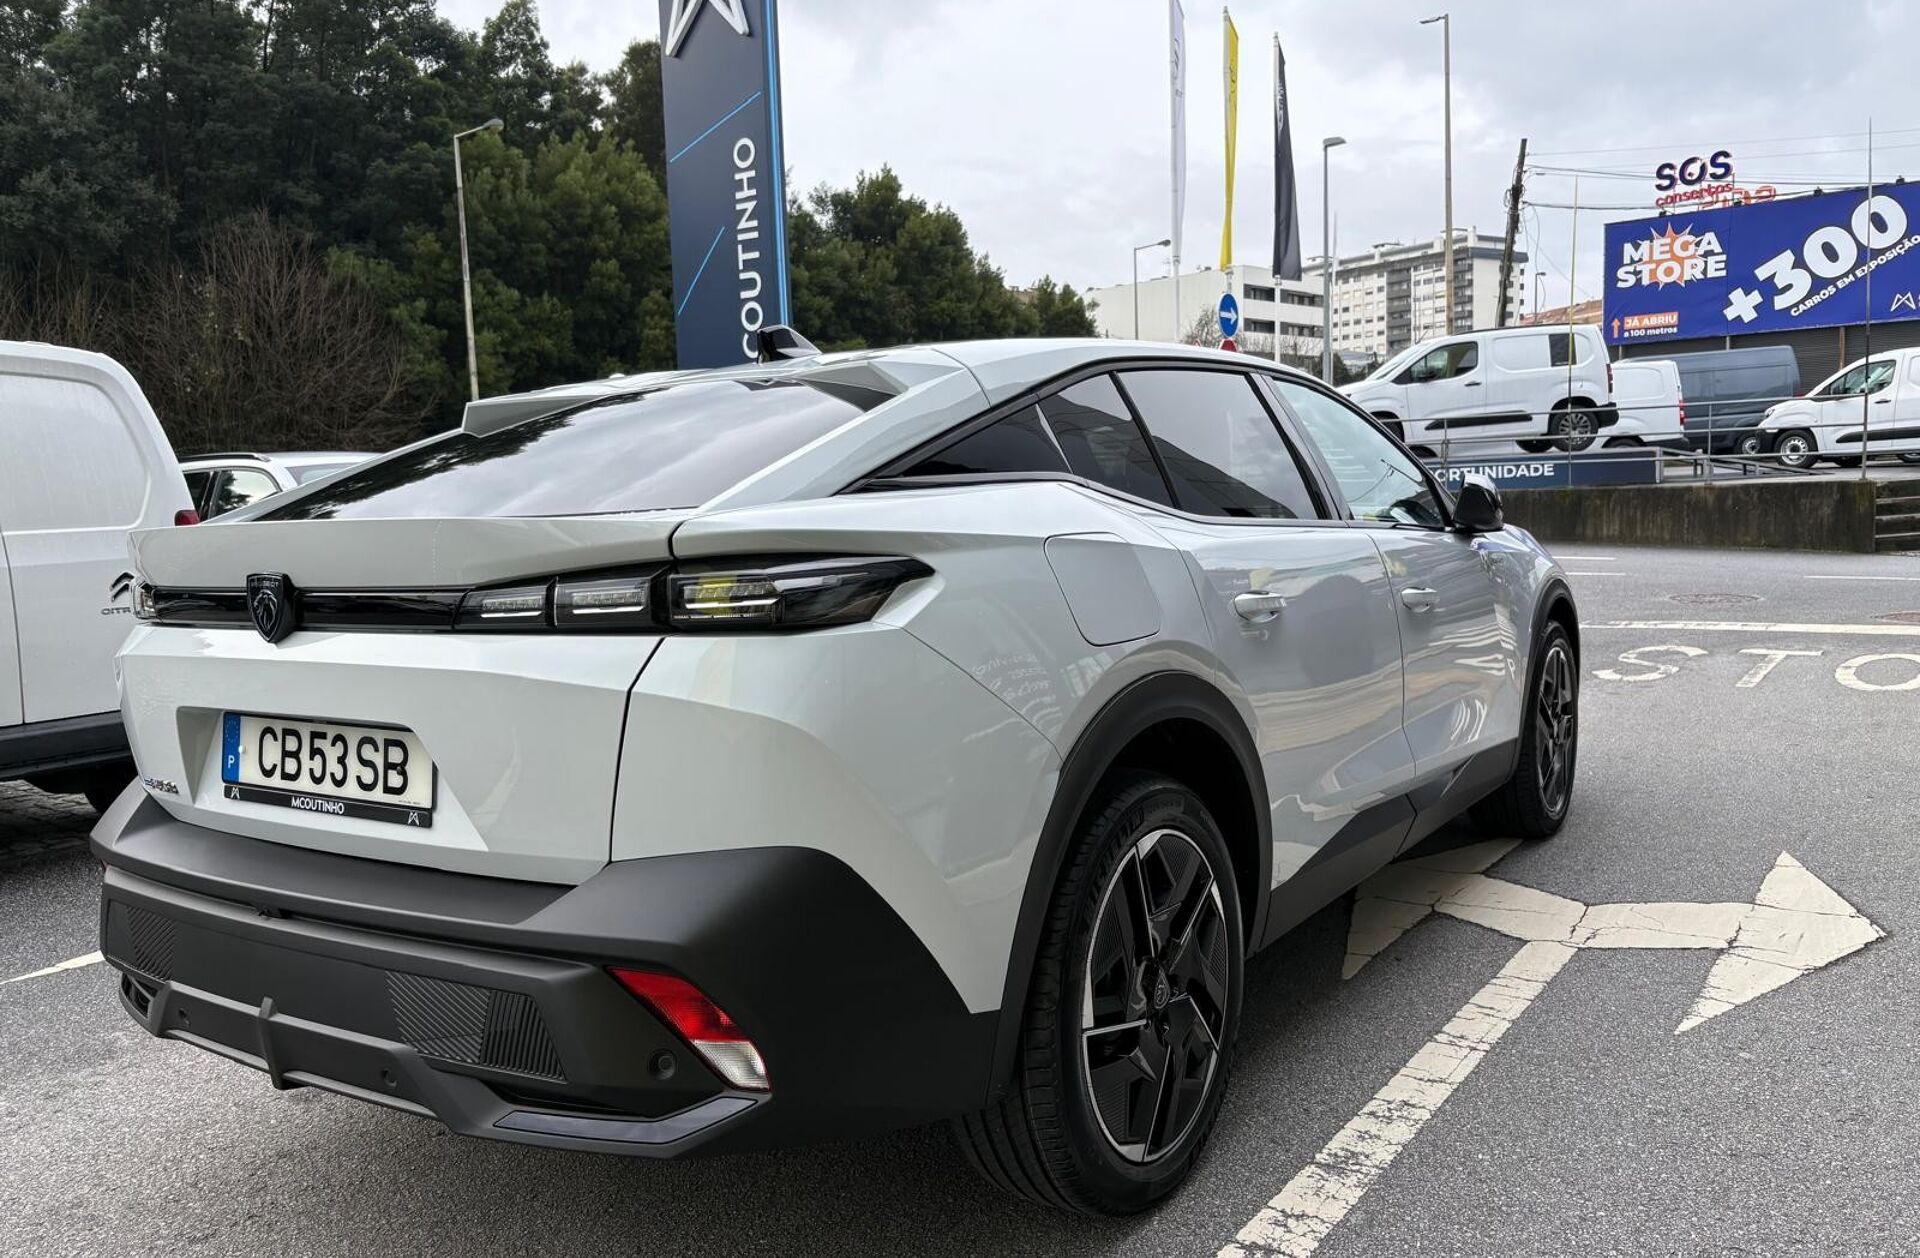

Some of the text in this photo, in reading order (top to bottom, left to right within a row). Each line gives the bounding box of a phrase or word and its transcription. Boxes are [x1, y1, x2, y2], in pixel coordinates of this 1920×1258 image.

[1655, 150, 1733, 191] SOS
[1656, 183, 1733, 207] consertos
[1623, 232, 1723, 264] MEGA
[1616, 254, 1727, 288] STORE
[1790, 235, 1920, 317] CARROS EM EXPOSIÇÃO
[1625, 314, 1677, 327] JÁ ABRIU
[1630, 328, 1645, 337] 100
[1647, 326, 1678, 336] metros
[227, 755, 235, 768] P
[291, 796, 345, 815] MCOUTINHO
